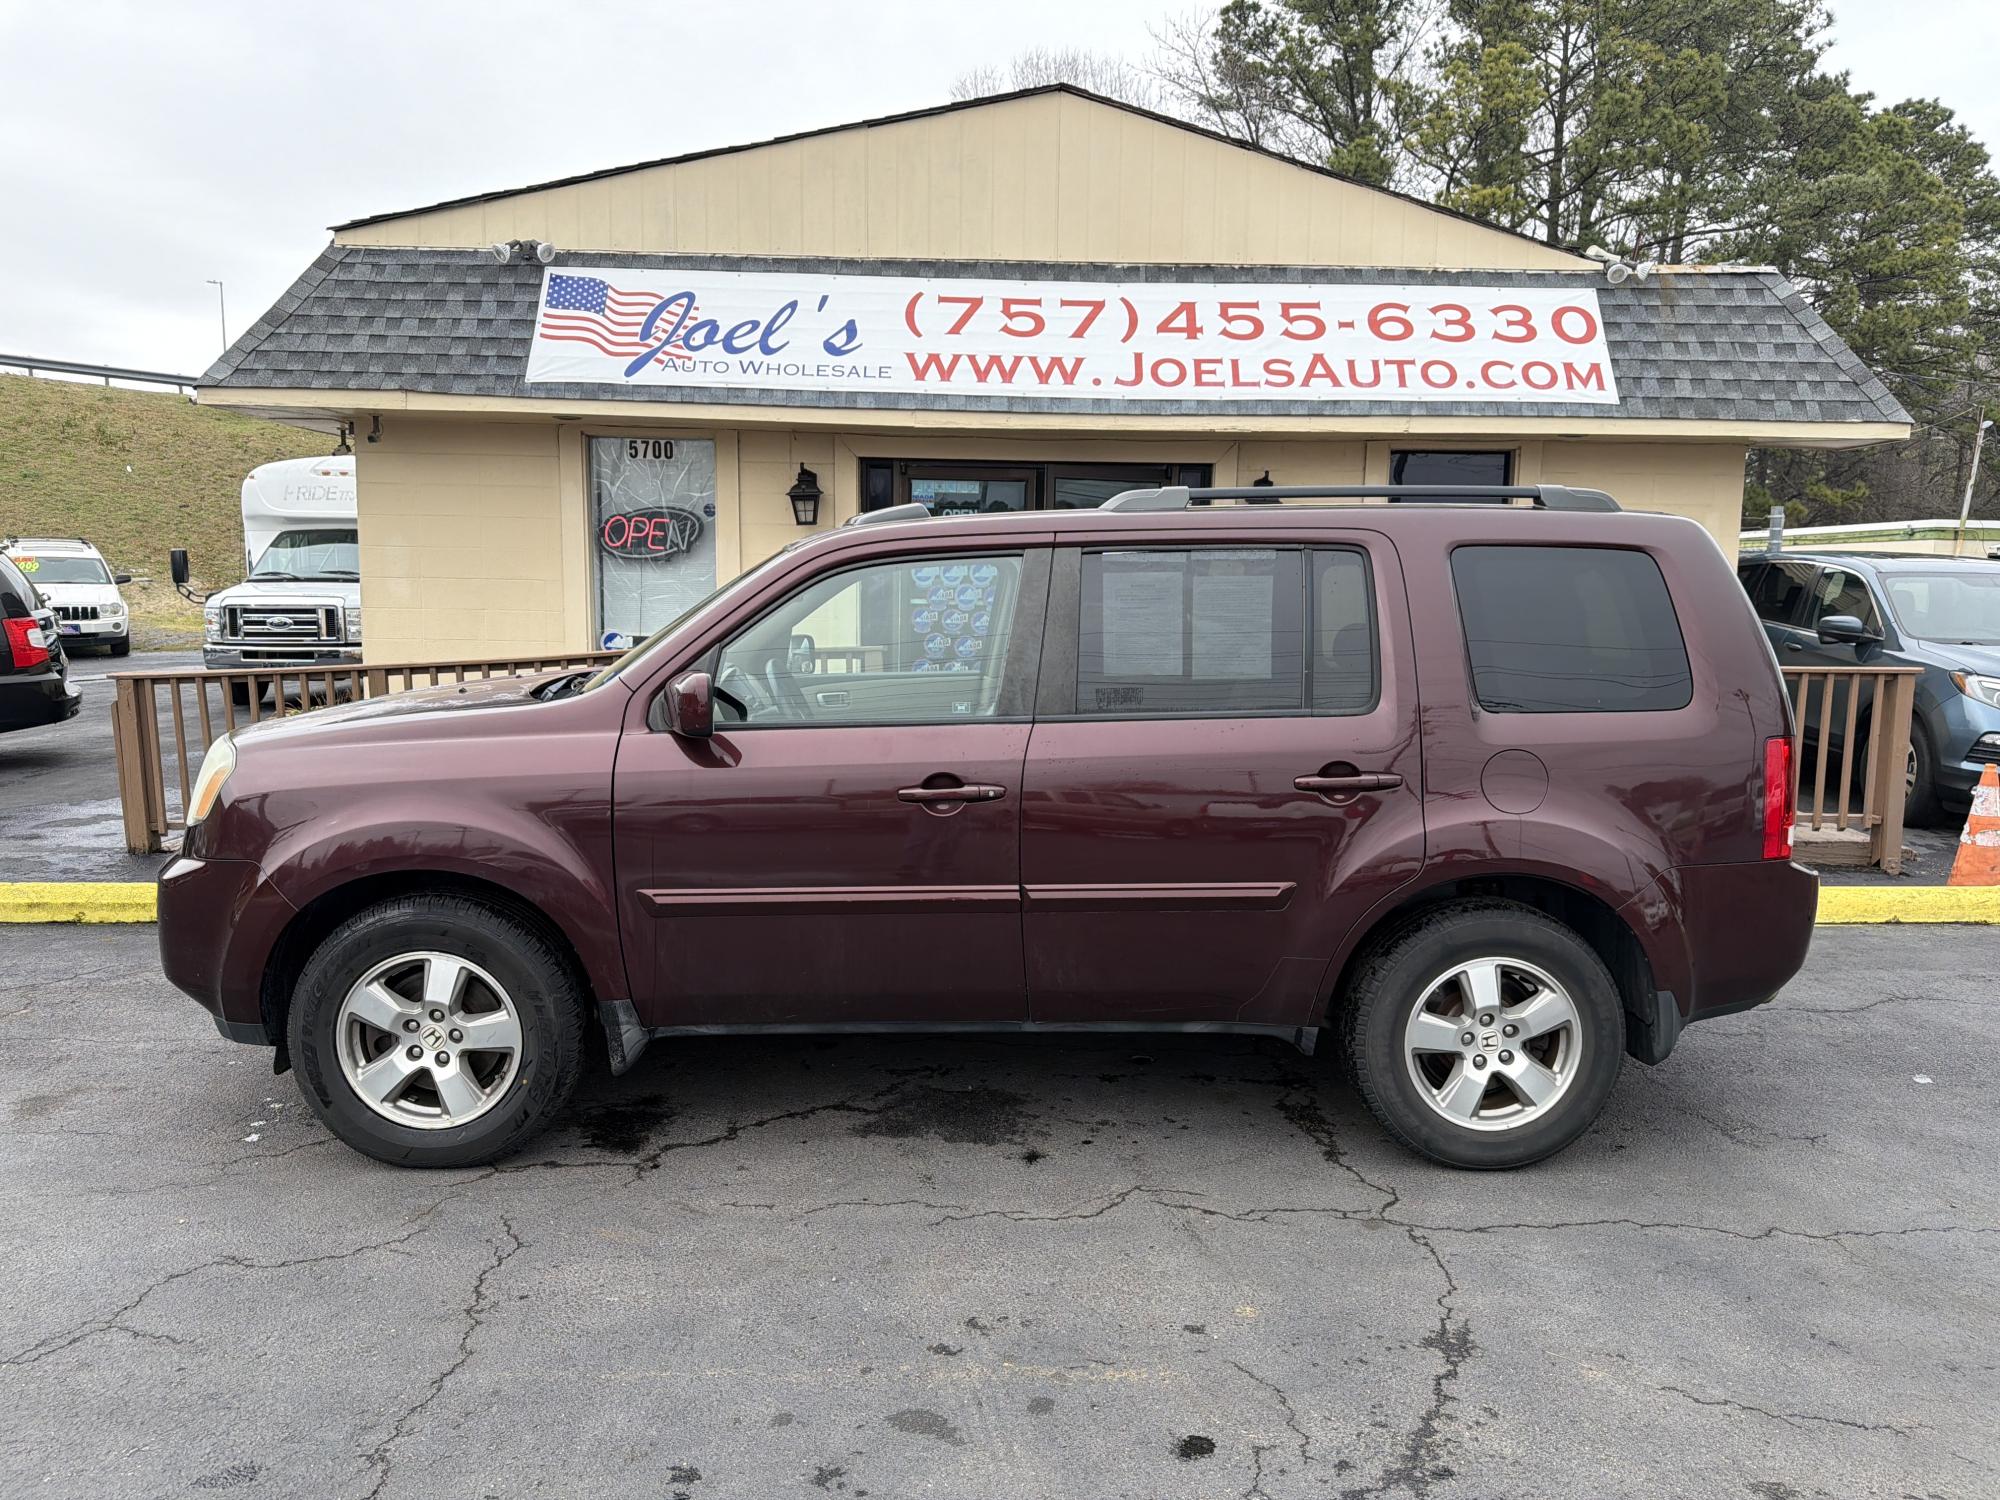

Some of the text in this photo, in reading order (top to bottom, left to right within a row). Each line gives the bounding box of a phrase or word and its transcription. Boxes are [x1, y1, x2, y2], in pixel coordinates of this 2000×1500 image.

[623, 290, 863, 378] Joel's
[905, 291, 1599, 345] (757)455-6330
[660, 356, 892, 379] AUTO WHOLESALE
[628, 440, 674, 460] 5700
[604, 515, 692, 551] OPEN
